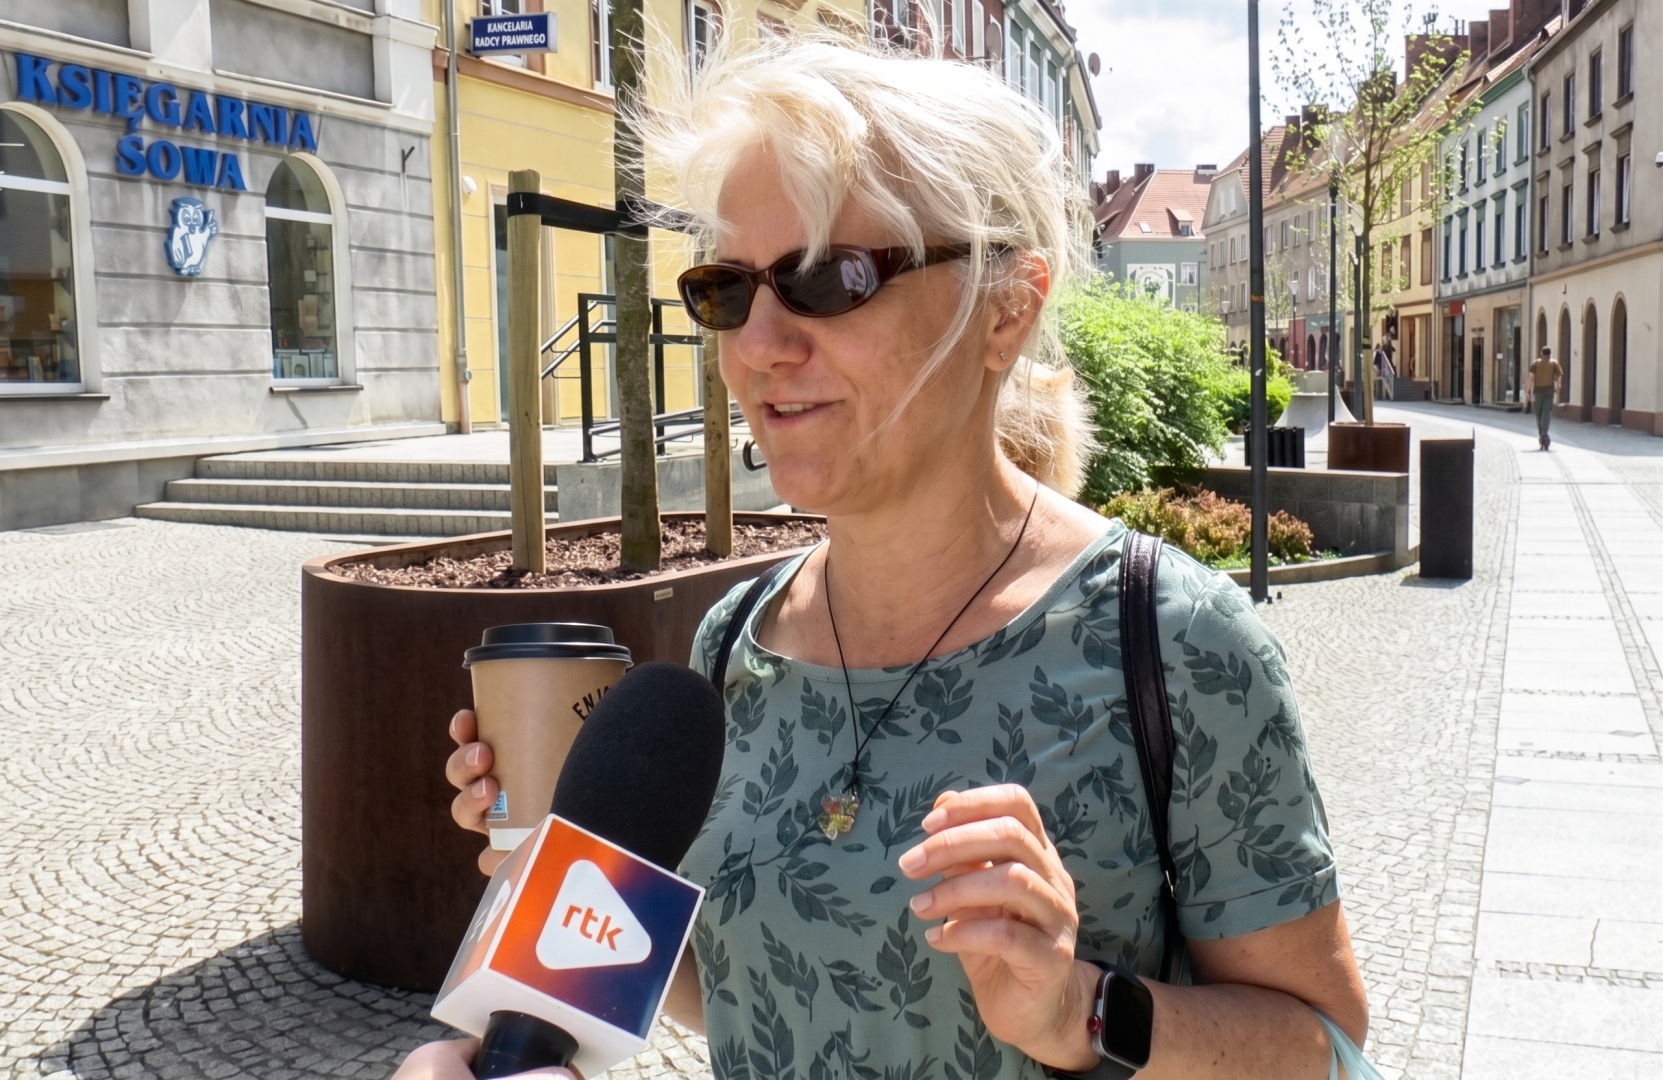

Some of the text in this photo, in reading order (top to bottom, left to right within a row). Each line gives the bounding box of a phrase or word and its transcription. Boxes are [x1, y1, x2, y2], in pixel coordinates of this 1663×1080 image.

[475, 33, 546, 47] RADCY PRAWNEGO
[487, 20, 533, 33] KANCELARIA
[16, 53, 317, 150] KSIĘGARNIA
[116, 134, 248, 191] SOWA
[572, 685, 609, 721] EN
[562, 904, 624, 952] rtk
